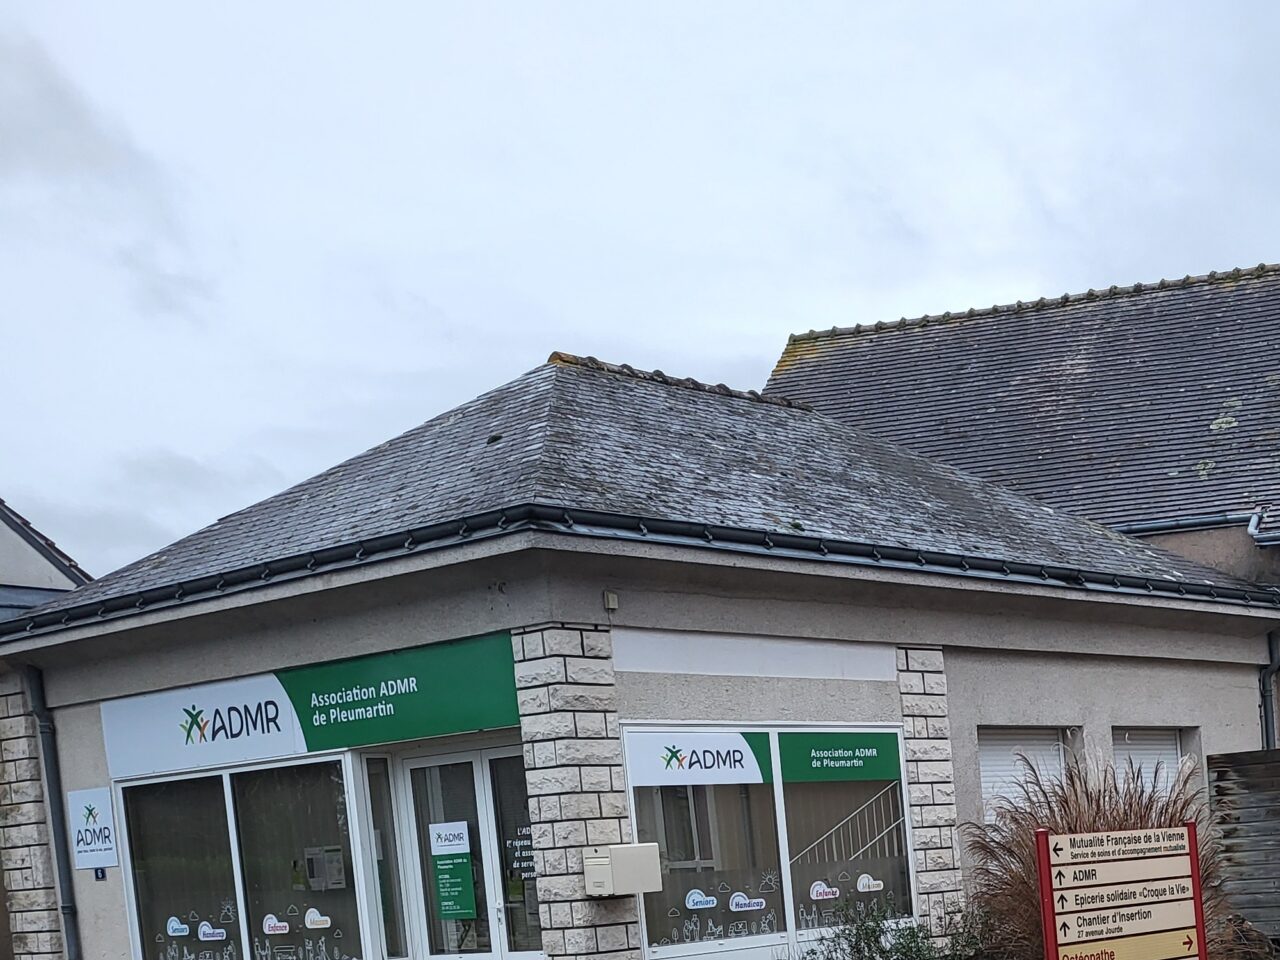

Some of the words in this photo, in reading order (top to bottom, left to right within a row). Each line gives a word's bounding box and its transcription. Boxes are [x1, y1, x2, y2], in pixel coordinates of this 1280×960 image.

[310, 685, 376, 708] Association
[379, 677, 418, 697] ADMR
[312, 710, 327, 726] de
[330, 701, 394, 724] Pleumartin
[211, 700, 281, 742] ADMR
[688, 749, 745, 769] ADMR
[810, 748, 853, 758] Association
[855, 748, 877, 757] ADMR
[811, 758, 822, 767] de
[823, 758, 863, 767] Pleumartin
[76, 826, 112, 847] ADMR
[444, 832, 464, 843] ADMR
[517, 827, 531, 836] L'AD
[512, 839, 532, 847] réseau
[1069, 834, 1104, 849] Mutualité
[1106, 834, 1142, 848] Française
[1144, 833, 1152, 844] de
[1153, 832, 1160, 843] la
[1161, 830, 1185, 842] Vienne
[1070, 851, 1089, 860] Service
[1090, 850, 1097, 859] de
[1097, 849, 1111, 858] soins
[1111, 848, 1117, 857] et
[1117, 846, 1162, 857] d'accompagnement
[512, 860, 520, 868] de
[1072, 868, 1098, 882] ADMR
[691, 898, 715, 906] Seniors
[1074, 892, 1105, 908] Epicerie
[1106, 889, 1137, 903] solidaire
[1168, 885, 1174, 896] la
[734, 901, 764, 910] Handicap
[1076, 913, 1109, 928] Chantier
[1111, 908, 1152, 924] d'Insertion
[1077, 930, 1084, 938] 27
[1085, 928, 1104, 938] avenue
[1105, 926, 1123, 935] Jourde
